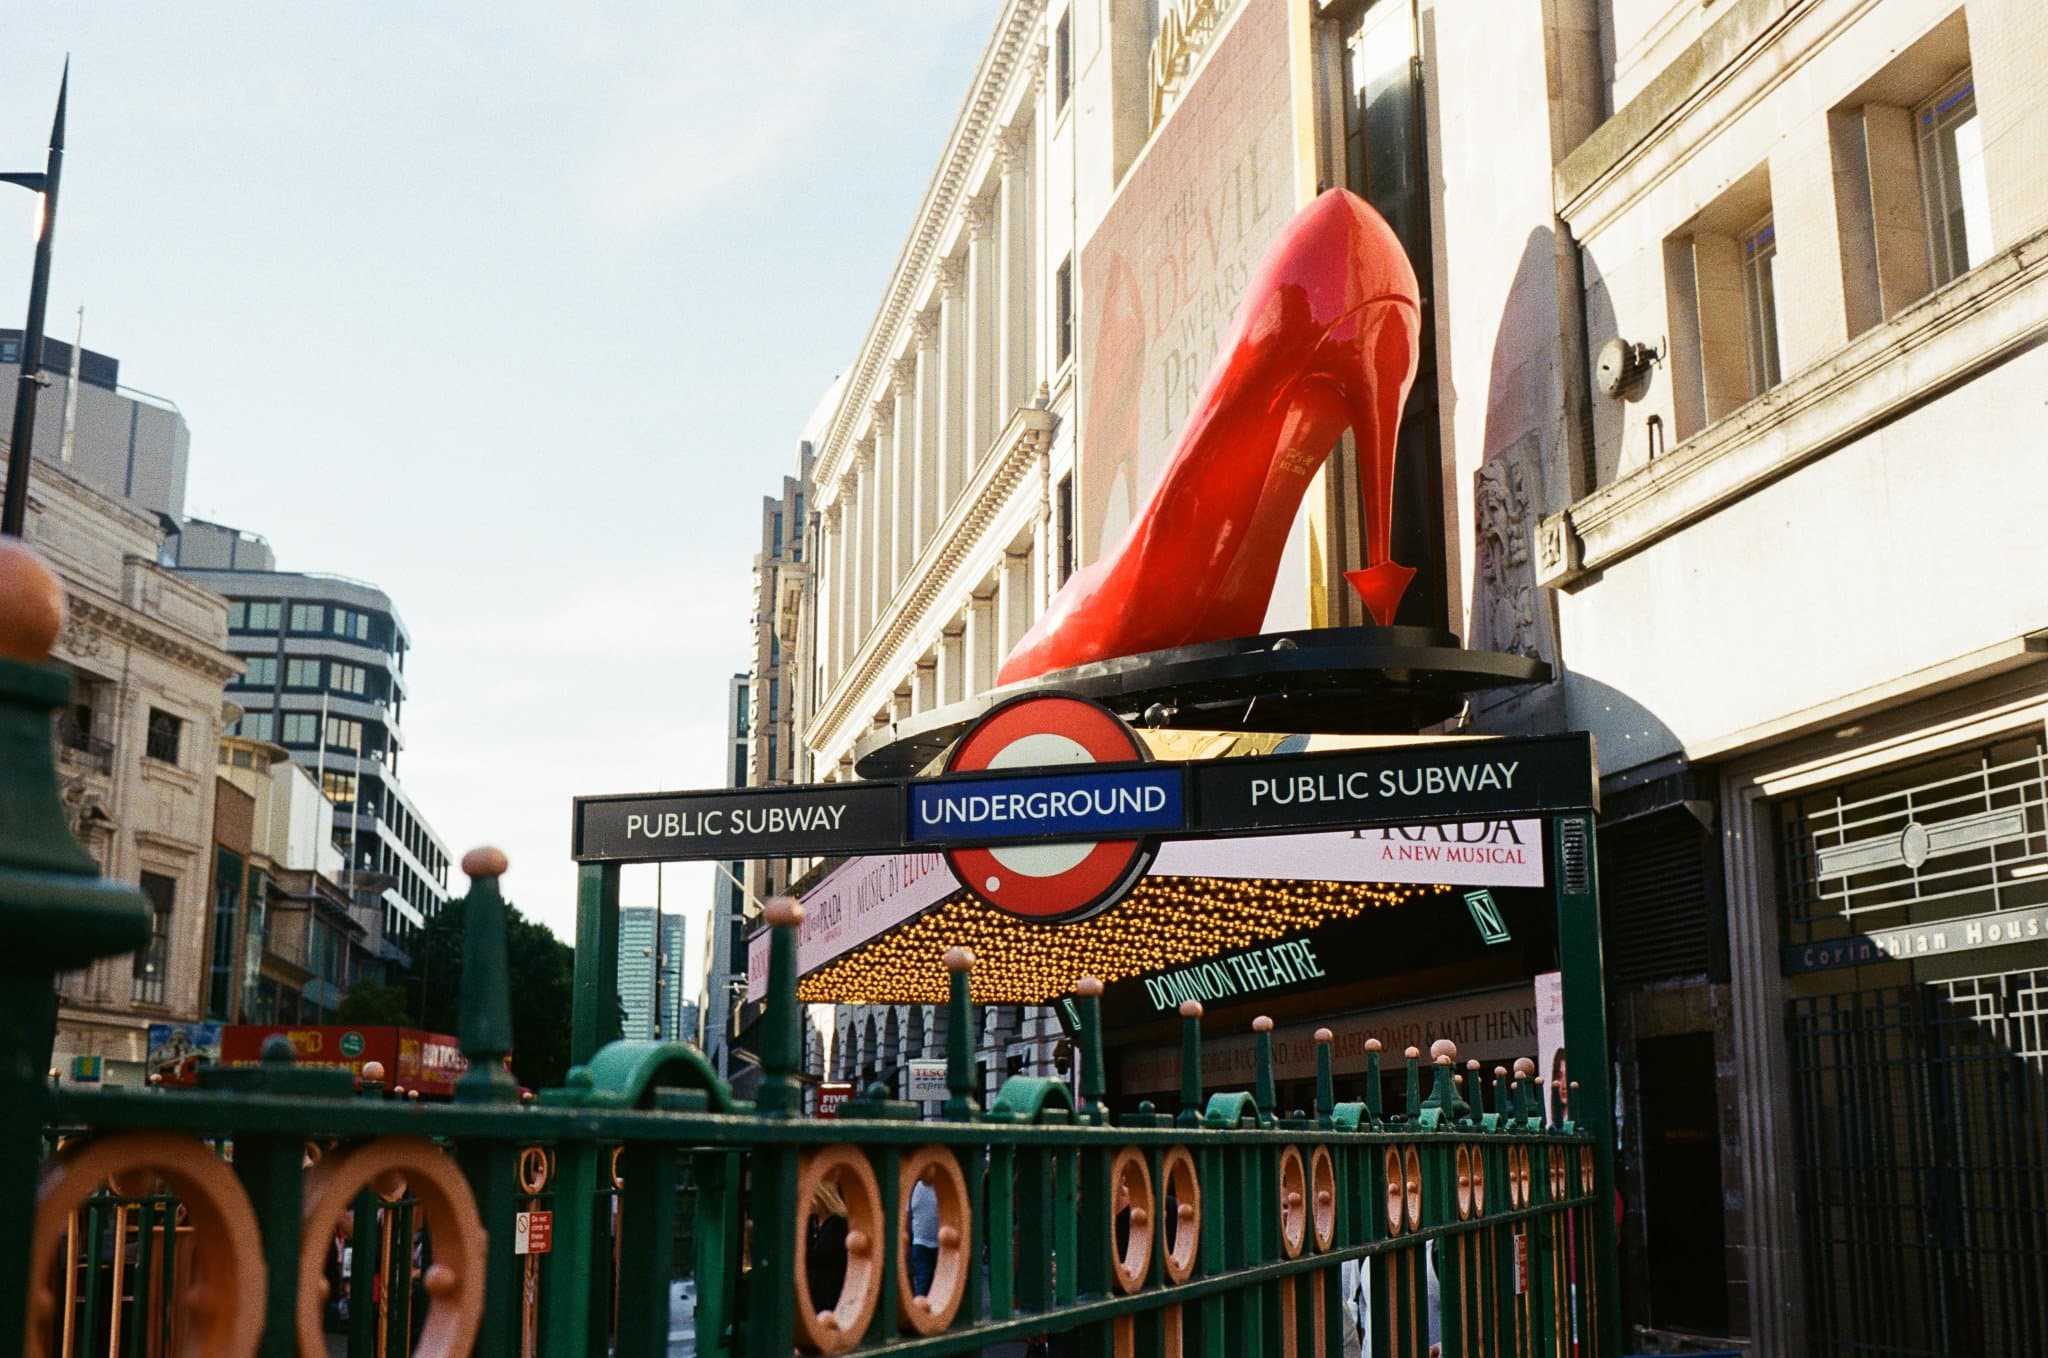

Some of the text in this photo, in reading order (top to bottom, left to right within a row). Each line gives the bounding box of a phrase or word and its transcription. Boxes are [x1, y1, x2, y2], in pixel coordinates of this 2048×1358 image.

[1252, 761, 1519, 806] PUBLIC SUBWAY
[627, 805, 847, 839] PUBLIC SUBWAY
[921, 786, 1167, 824] UNDERGROUND
[1381, 845, 1526, 865] A NEW MUSICAL
[857, 864, 886, 917] MUSIC
[888, 856, 899, 897] BY
[1804, 917, 2048, 967] Corinthian Hous
[1144, 938, 1326, 1010] DOMINION THEATRE
[1440, 1014, 1480, 1044] MATT
[1485, 1007, 1537, 1041] HENR
[914, 1068, 947, 1077] TESC
[820, 1104, 837, 1113] GU
[823, 1095, 848, 1104] FIVE
